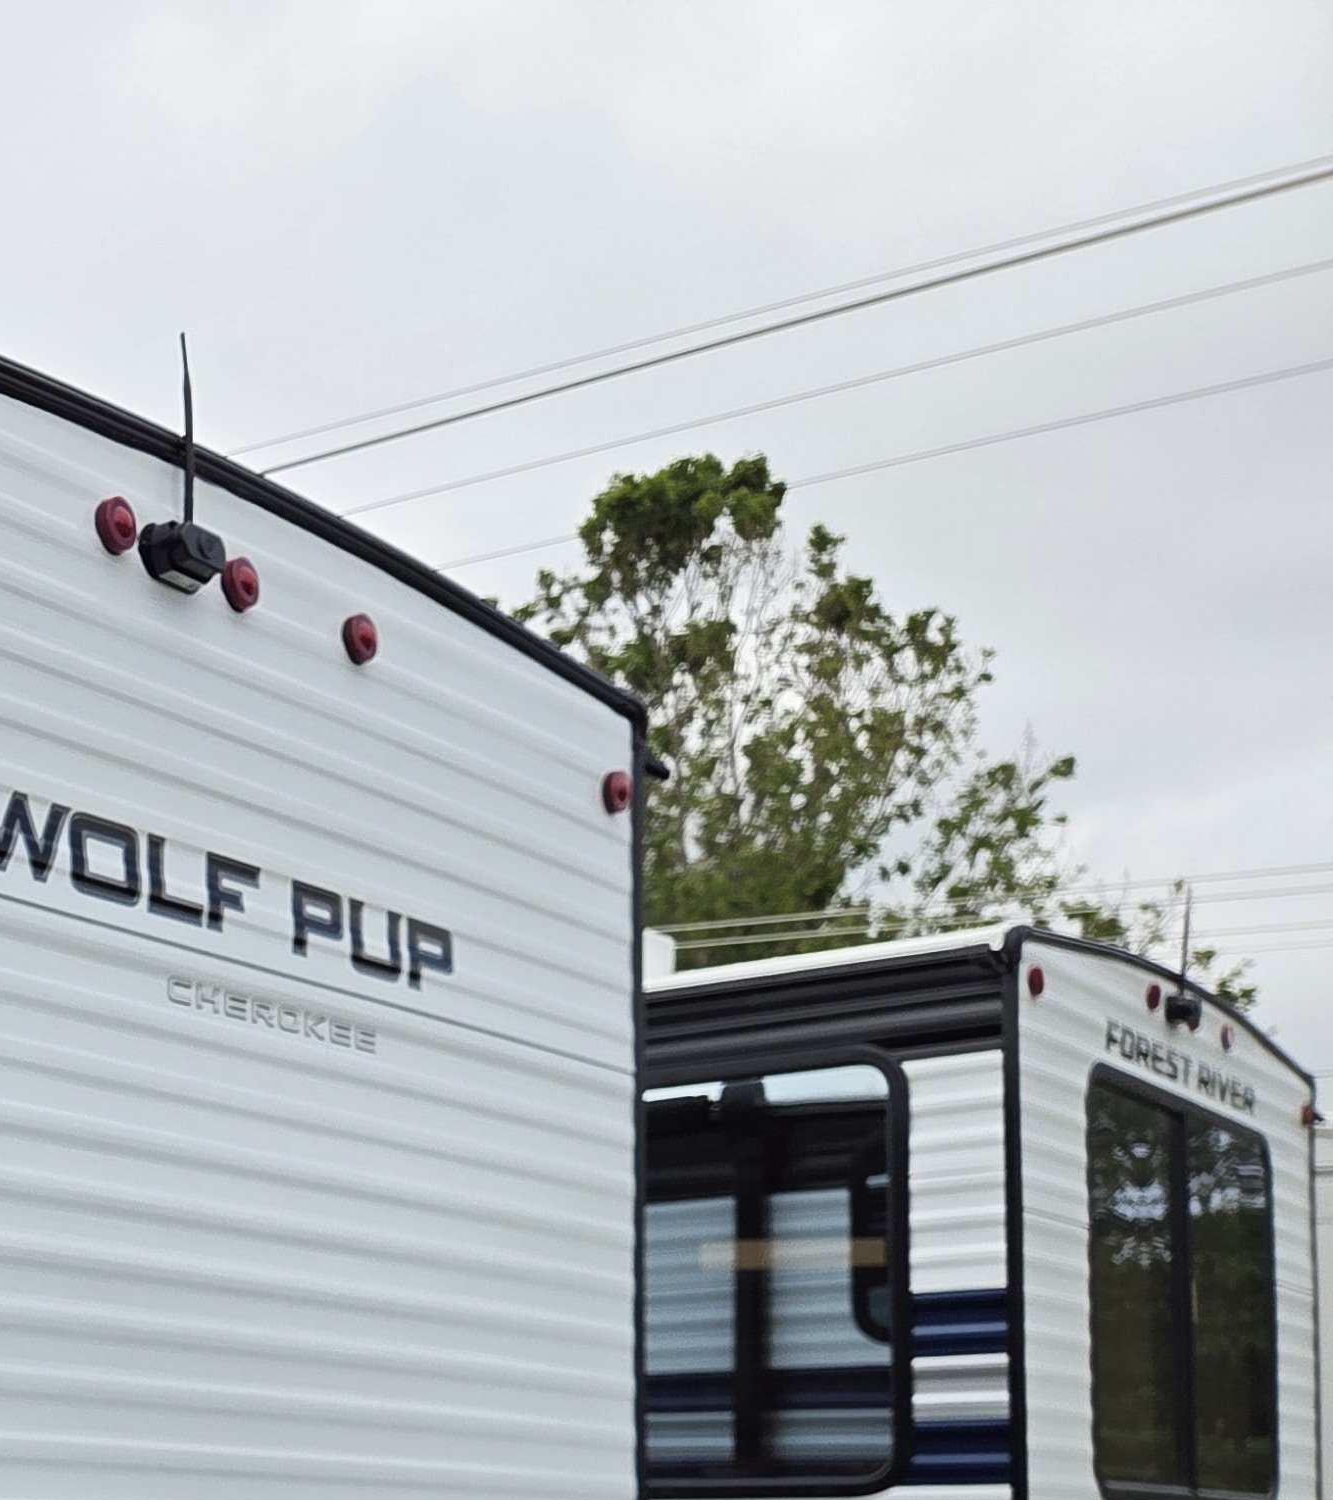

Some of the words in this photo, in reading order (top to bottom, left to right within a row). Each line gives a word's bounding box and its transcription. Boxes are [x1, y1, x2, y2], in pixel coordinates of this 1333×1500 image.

[291, 877, 455, 991] PUP
[166, 974, 378, 1055] CHEROKEE
[1105, 1017, 1193, 1086] FOREST
[1198, 1060, 1256, 1116] RIVER
